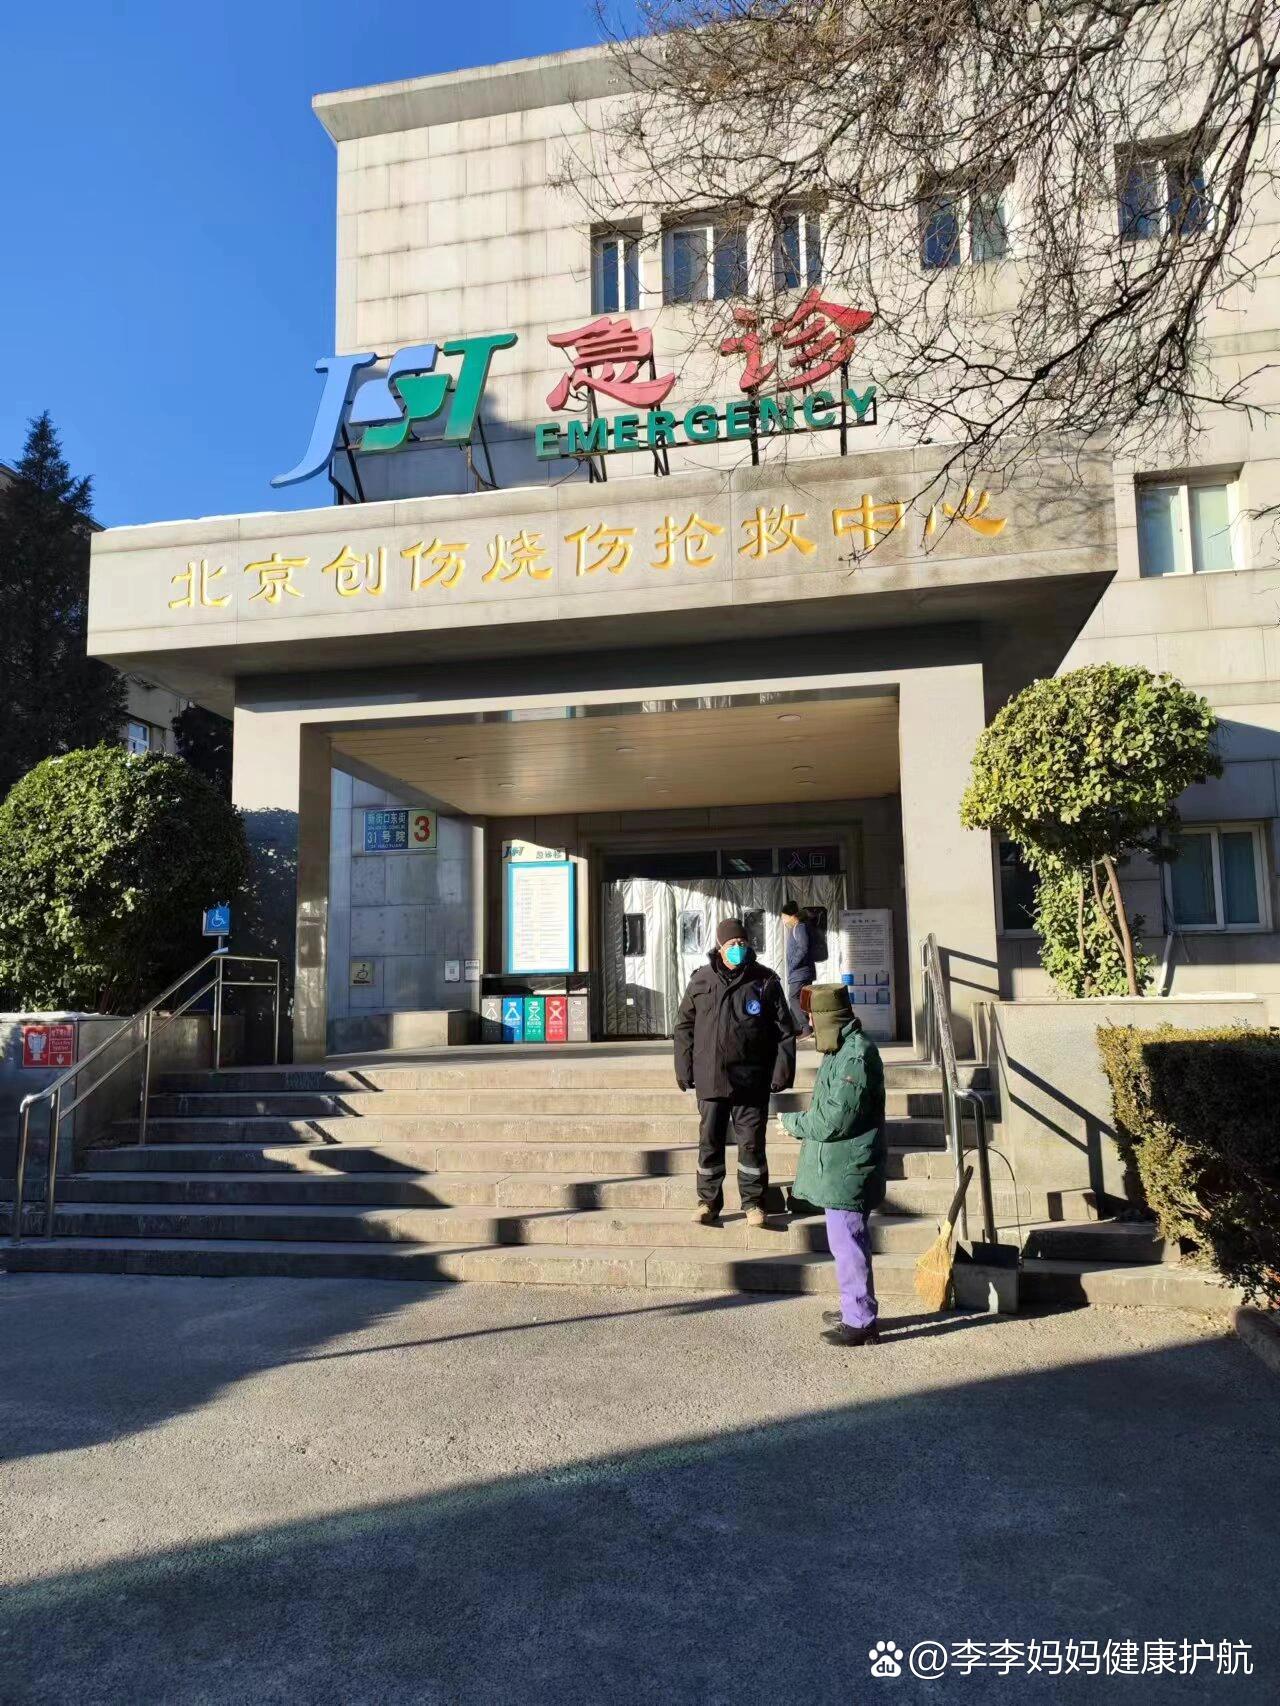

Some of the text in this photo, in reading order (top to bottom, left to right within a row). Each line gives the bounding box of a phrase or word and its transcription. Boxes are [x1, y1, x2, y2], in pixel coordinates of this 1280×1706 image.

[546, 288, 875, 412] 急诊
[270, 332, 518, 489] JST
[536, 386, 878, 462] EMERGENCY
[168, 487, 1009, 610] 北京创伤烧伤抢救中心
[414, 815, 431, 842] 3
[787, 851, 826, 869] 入口
